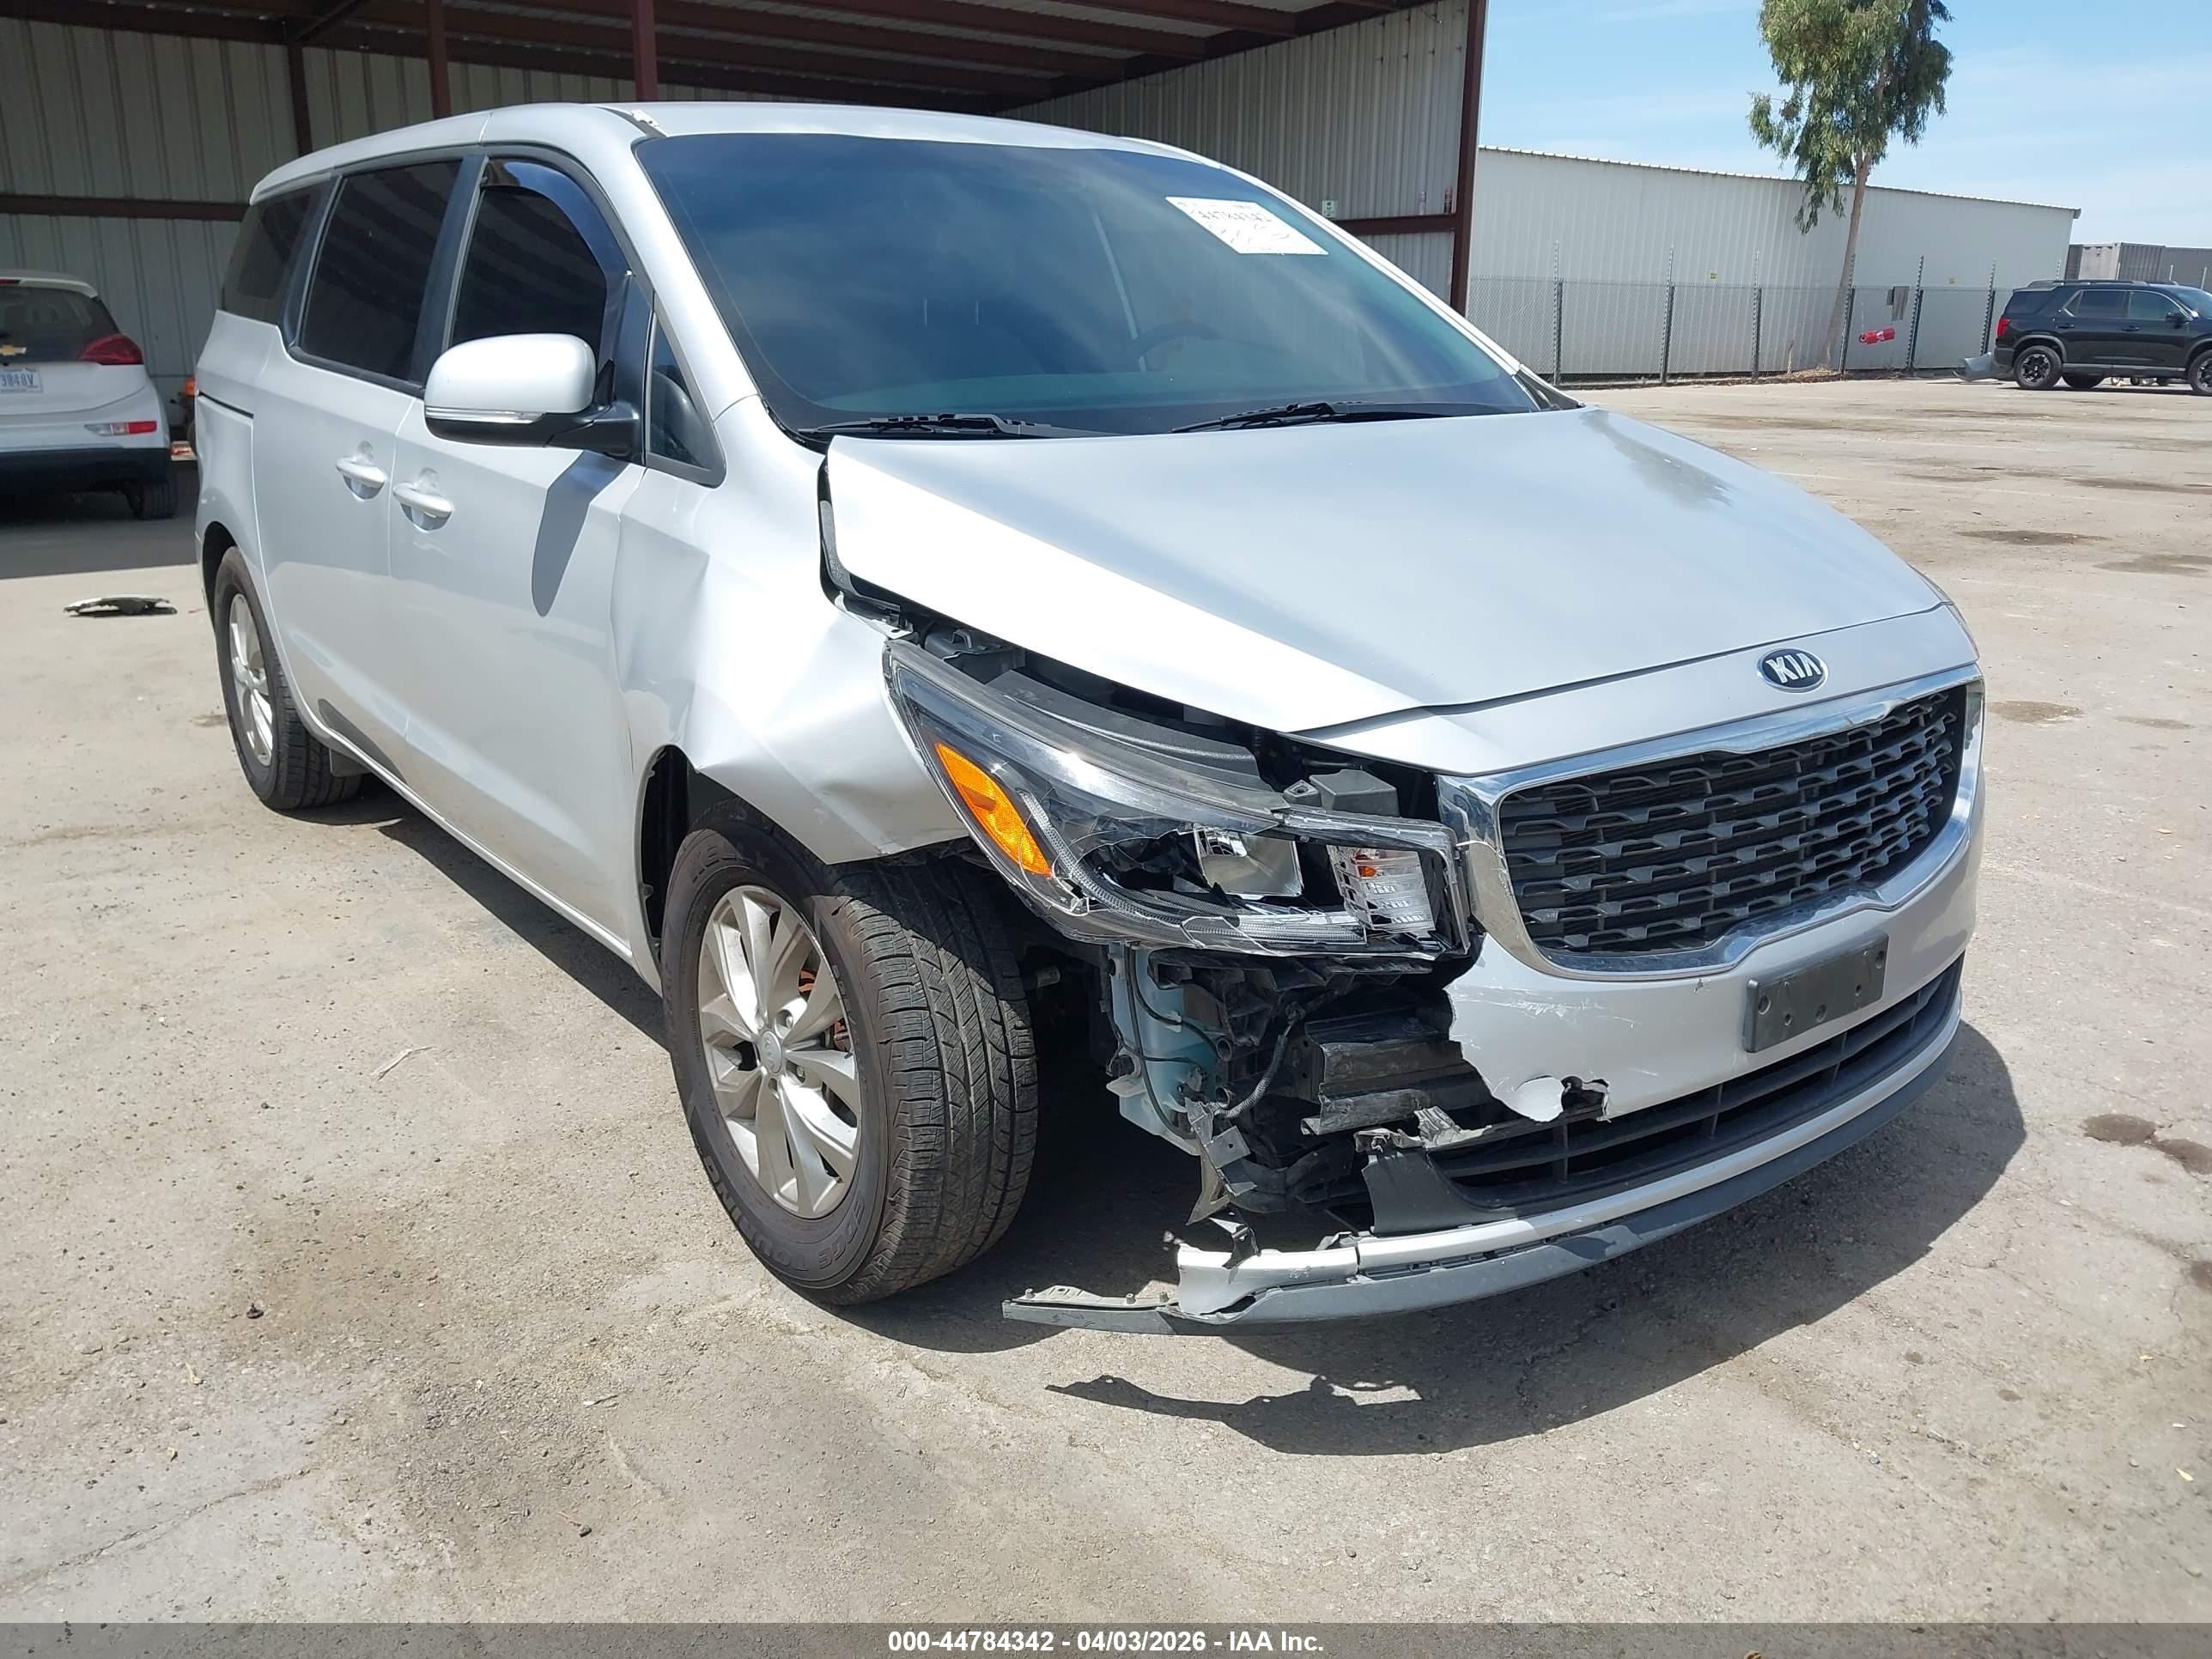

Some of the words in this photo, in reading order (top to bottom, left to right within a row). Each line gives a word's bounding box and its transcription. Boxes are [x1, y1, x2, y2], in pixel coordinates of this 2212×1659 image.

[1765, 653, 1822, 684] KIA
[703, 1155, 809, 1272] TOURING
[817, 1200, 866, 1270] EDGE
